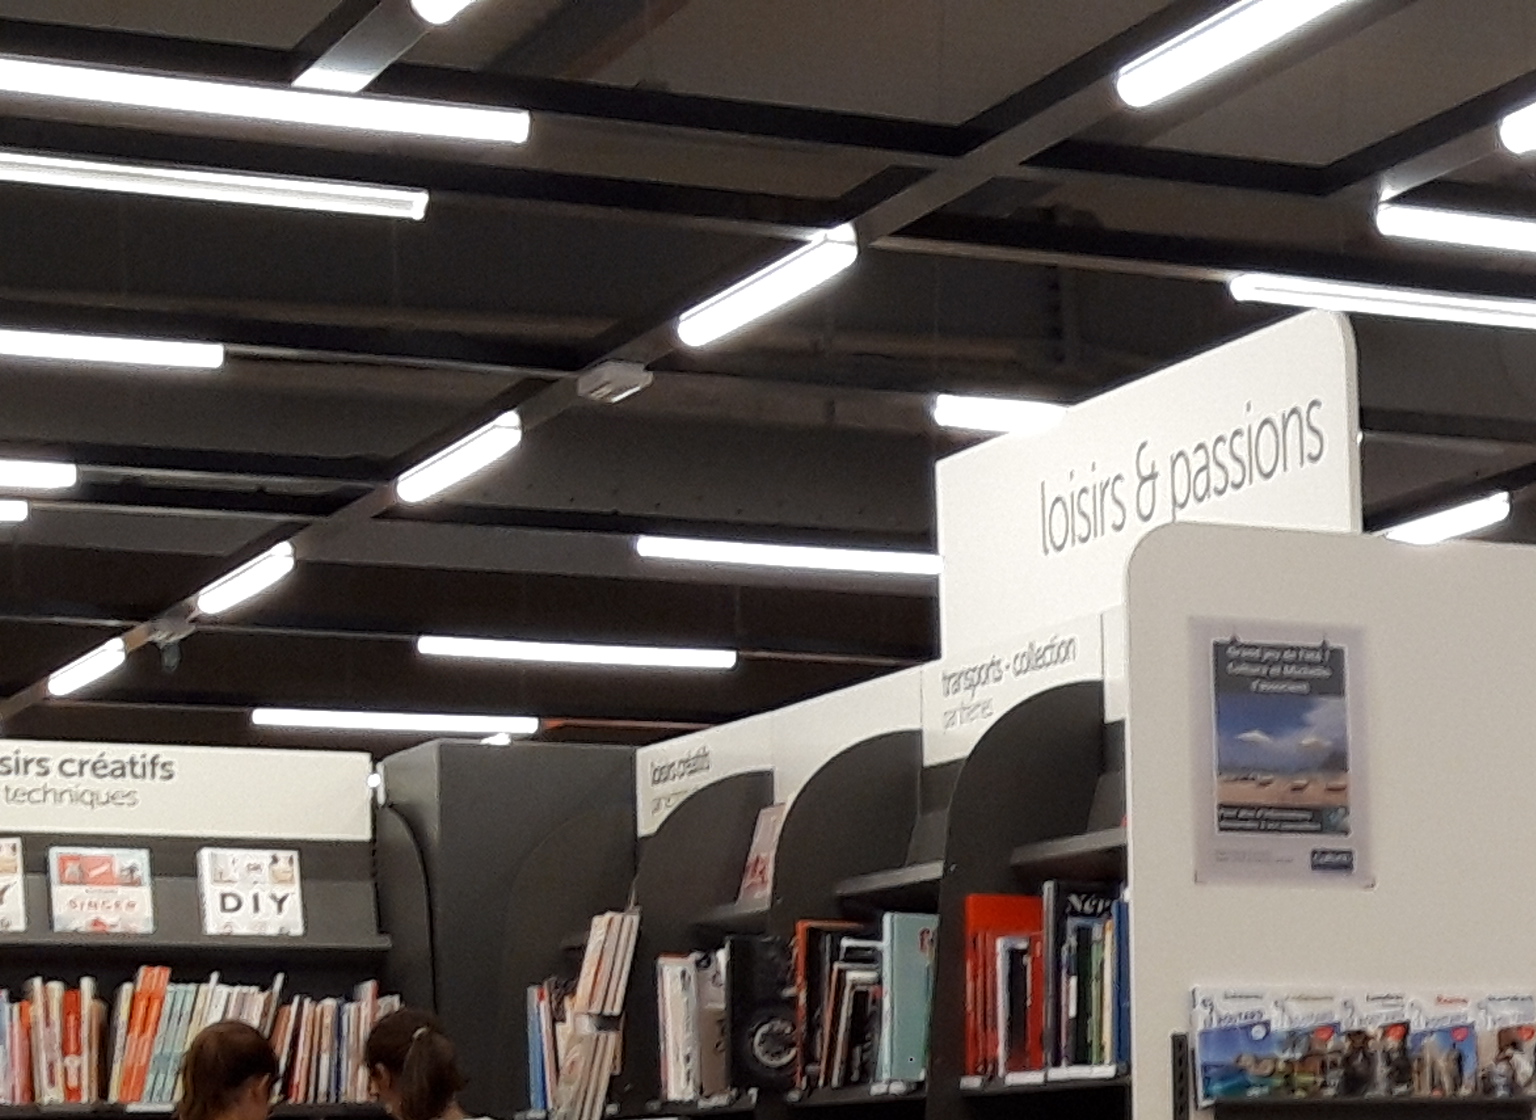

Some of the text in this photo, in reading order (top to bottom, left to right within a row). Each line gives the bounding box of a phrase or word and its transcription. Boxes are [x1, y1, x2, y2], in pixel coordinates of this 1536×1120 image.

[1038, 398, 1326, 556] loisirs & passions
[1012, 634, 1078, 679] collection
[58, 752, 175, 781] créatifs
[4, 785, 139, 809] techniques
[219, 892, 290, 914] DIY
